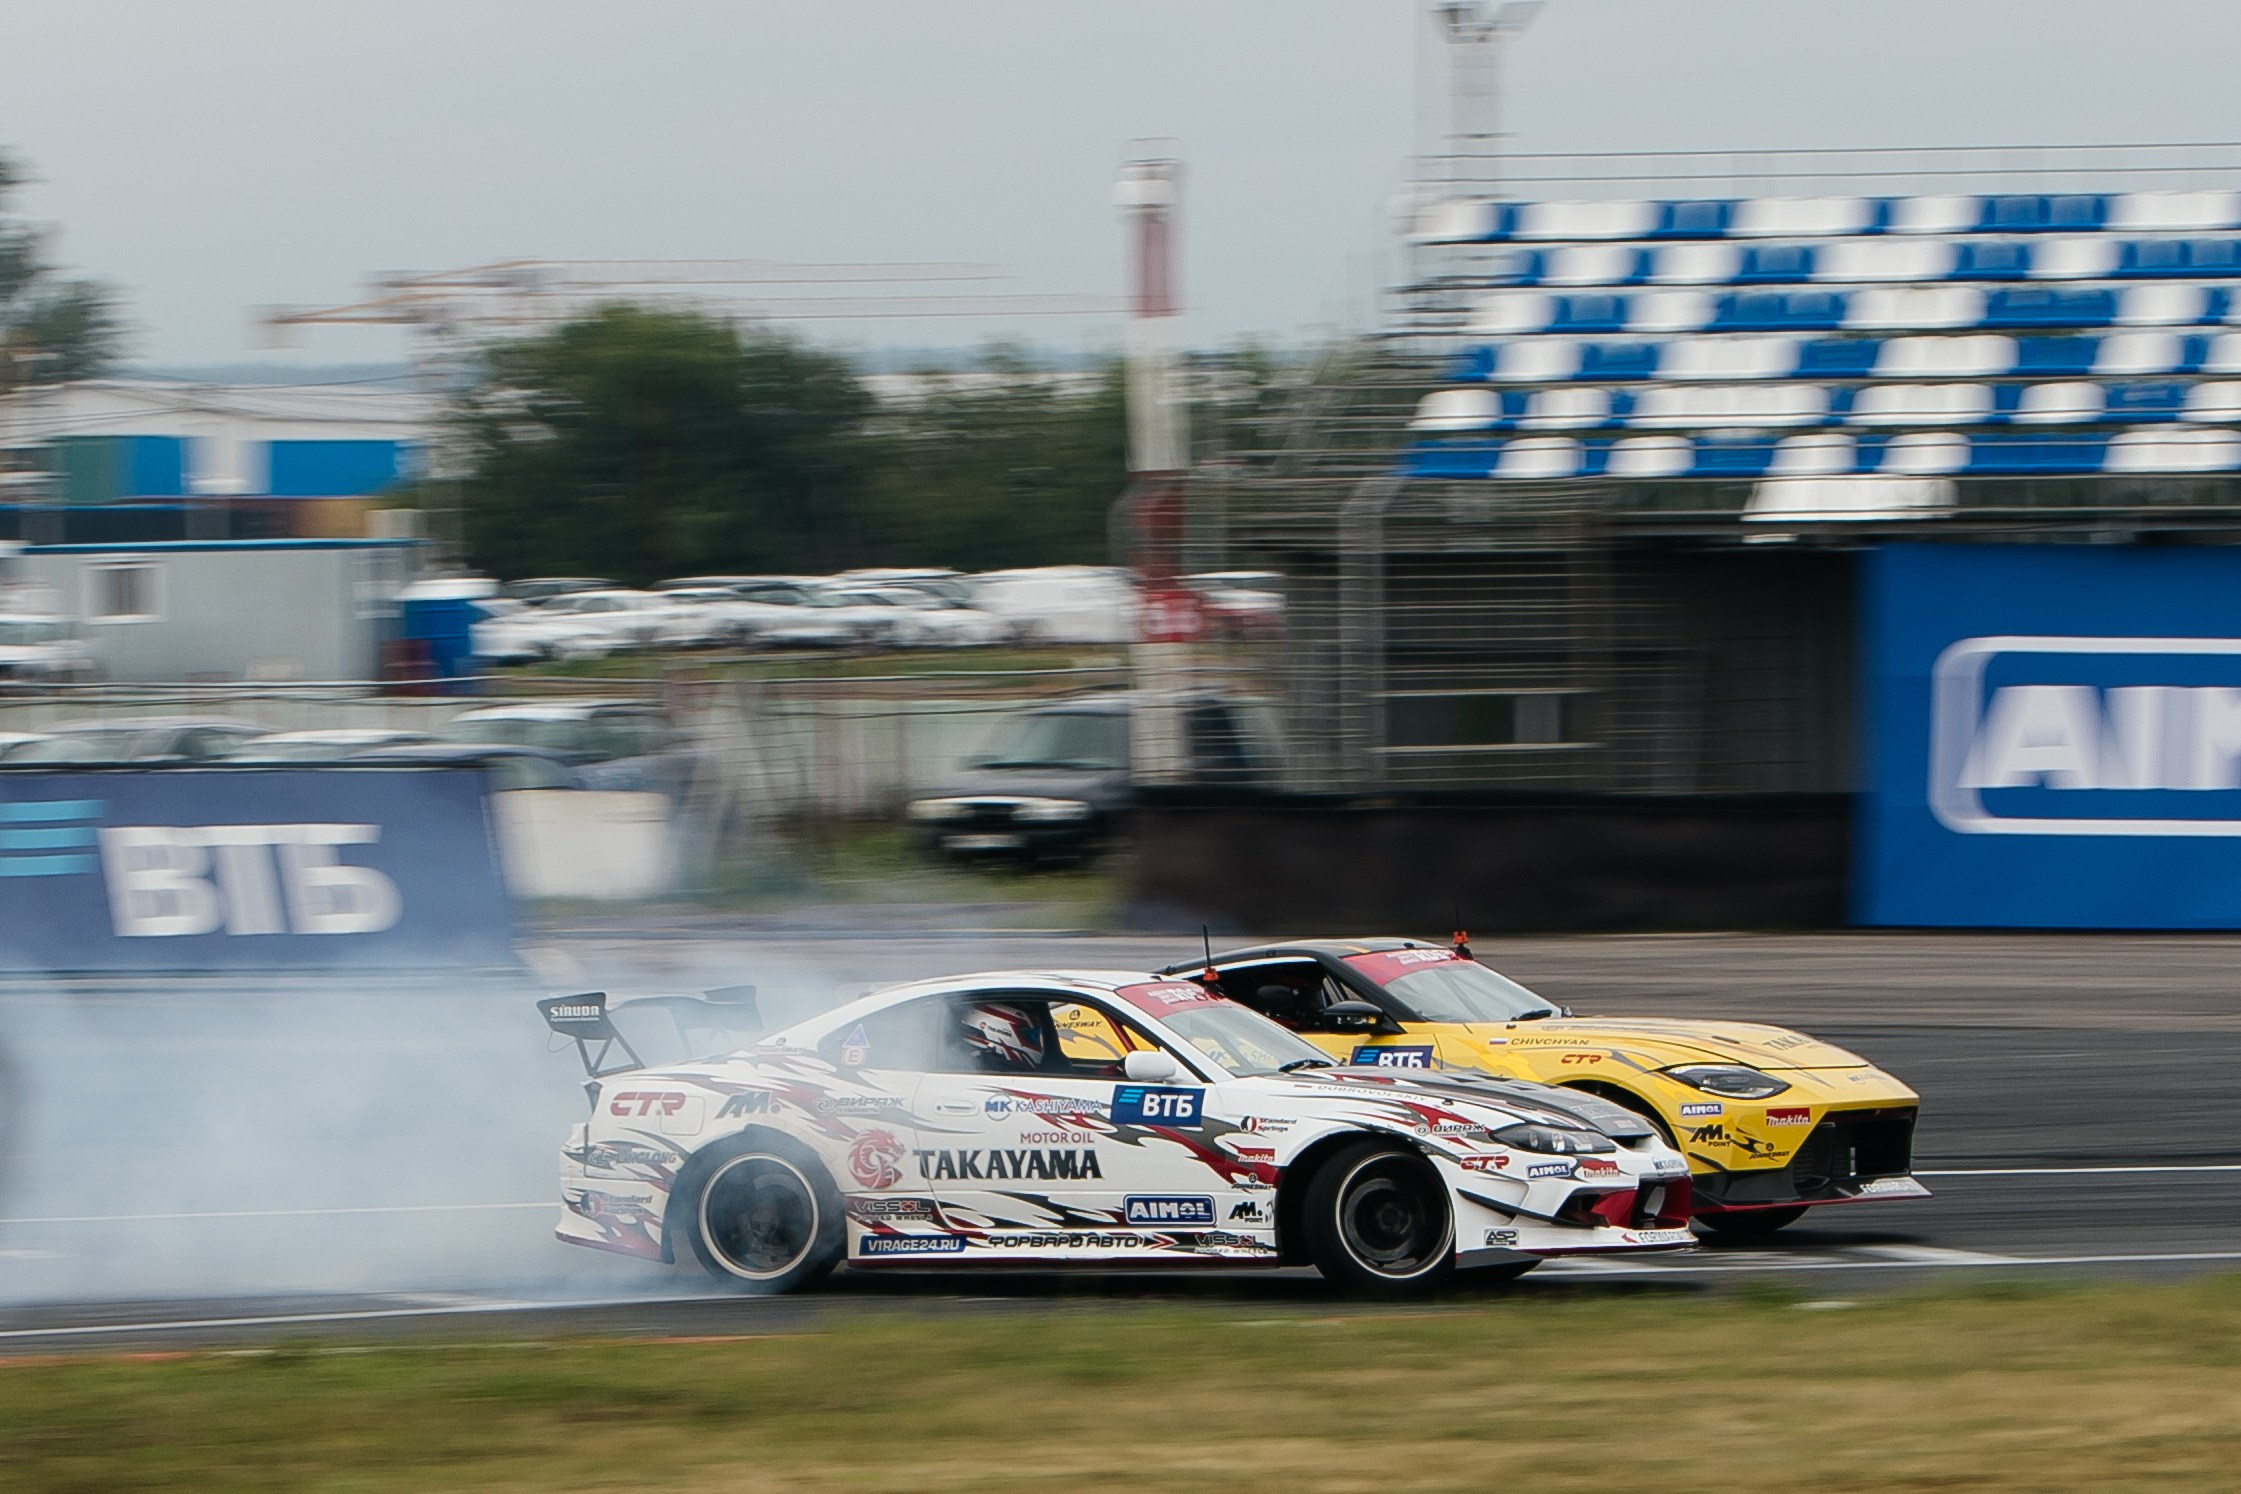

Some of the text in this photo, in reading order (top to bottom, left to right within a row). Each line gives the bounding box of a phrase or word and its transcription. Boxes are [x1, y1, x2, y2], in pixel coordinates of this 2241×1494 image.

[102, 823, 402, 937] ВТБ
[1511, 1038, 1590, 1046] CHIVCHYAN
[1561, 1054, 1602, 1064] CTR
[610, 1091, 686, 1116] CTR
[1015, 1100, 1102, 1113] KASHIYAMA
[1142, 1093, 1194, 1118] ВТБ
[1681, 1105, 1721, 1115] AIMOL
[1020, 1132, 1095, 1144] MOTOR OIL
[912, 1149, 1105, 1180] TAKAYAMA
[1460, 1156, 1510, 1170] CTR
[1529, 1163, 1569, 1177] AIMOL
[855, 1200, 931, 1213] VISSOL
[1130, 1202, 1211, 1219] AIMOL
[868, 1240, 960, 1251] VIRAGE24.RU
[1086, 1235, 1138, 1248] АВТО
[1195, 1235, 1265, 1246] VISSOL
